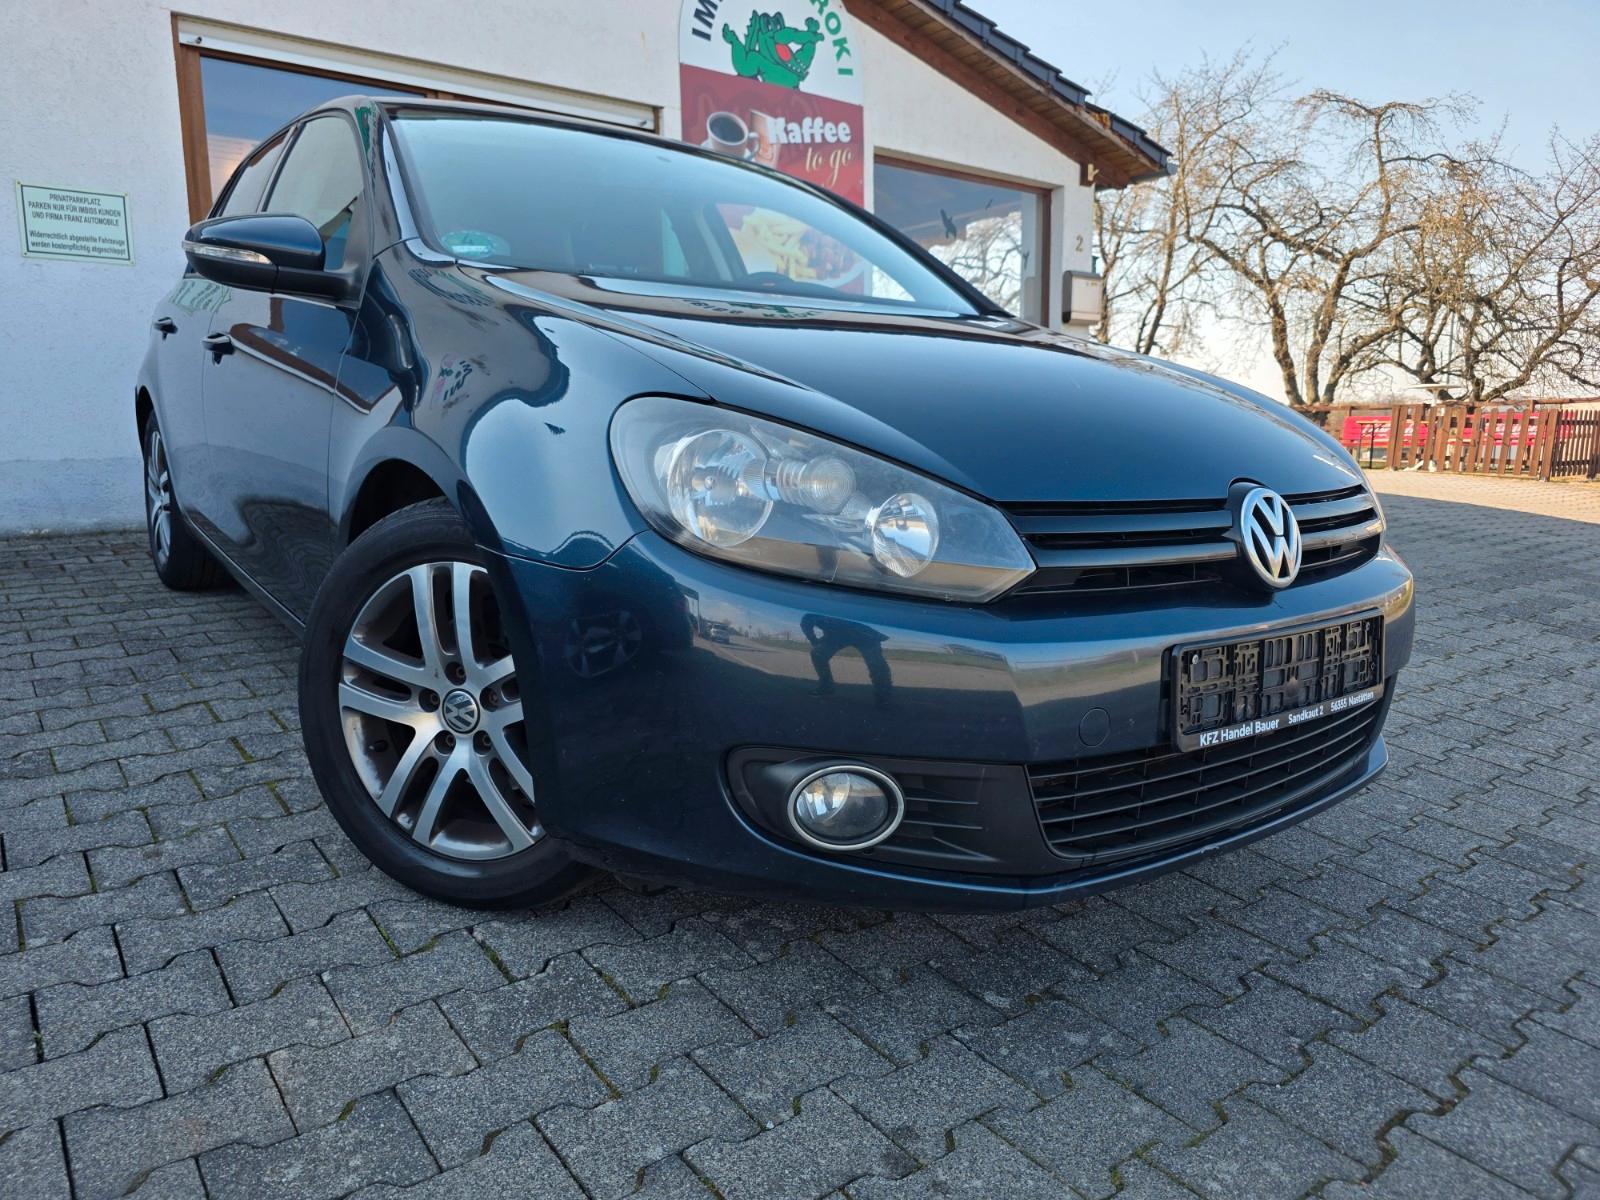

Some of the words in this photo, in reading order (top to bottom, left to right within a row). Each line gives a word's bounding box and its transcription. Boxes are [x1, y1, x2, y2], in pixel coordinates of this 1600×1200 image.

[692, 0, 724, 41] IM
[767, 116, 852, 144] Kaffee
[805, 147, 822, 173] to
[829, 147, 852, 187] go
[28, 200, 51, 210] PARKEN
[52, 203, 65, 212] NUR
[66, 203, 78, 213] FÜR
[98, 208, 121, 217] KUNDEN
[49, 193, 101, 206] PRIVATPARKPLATZ
[32, 211, 44, 219] UND
[45, 212, 63, 221] FIRMA
[64, 214, 83, 224] FRANZ
[84, 216, 119, 227] AUTOMOBILE
[1075, 235, 1084, 253] 2
[1200, 731, 1219, 747] KFZ
[1221, 722, 1253, 742] Handel
[1255, 719, 1280, 734] Bauer
[1288, 708, 1319, 724] Sandkaut
[1319, 705, 1324, 715] 2
